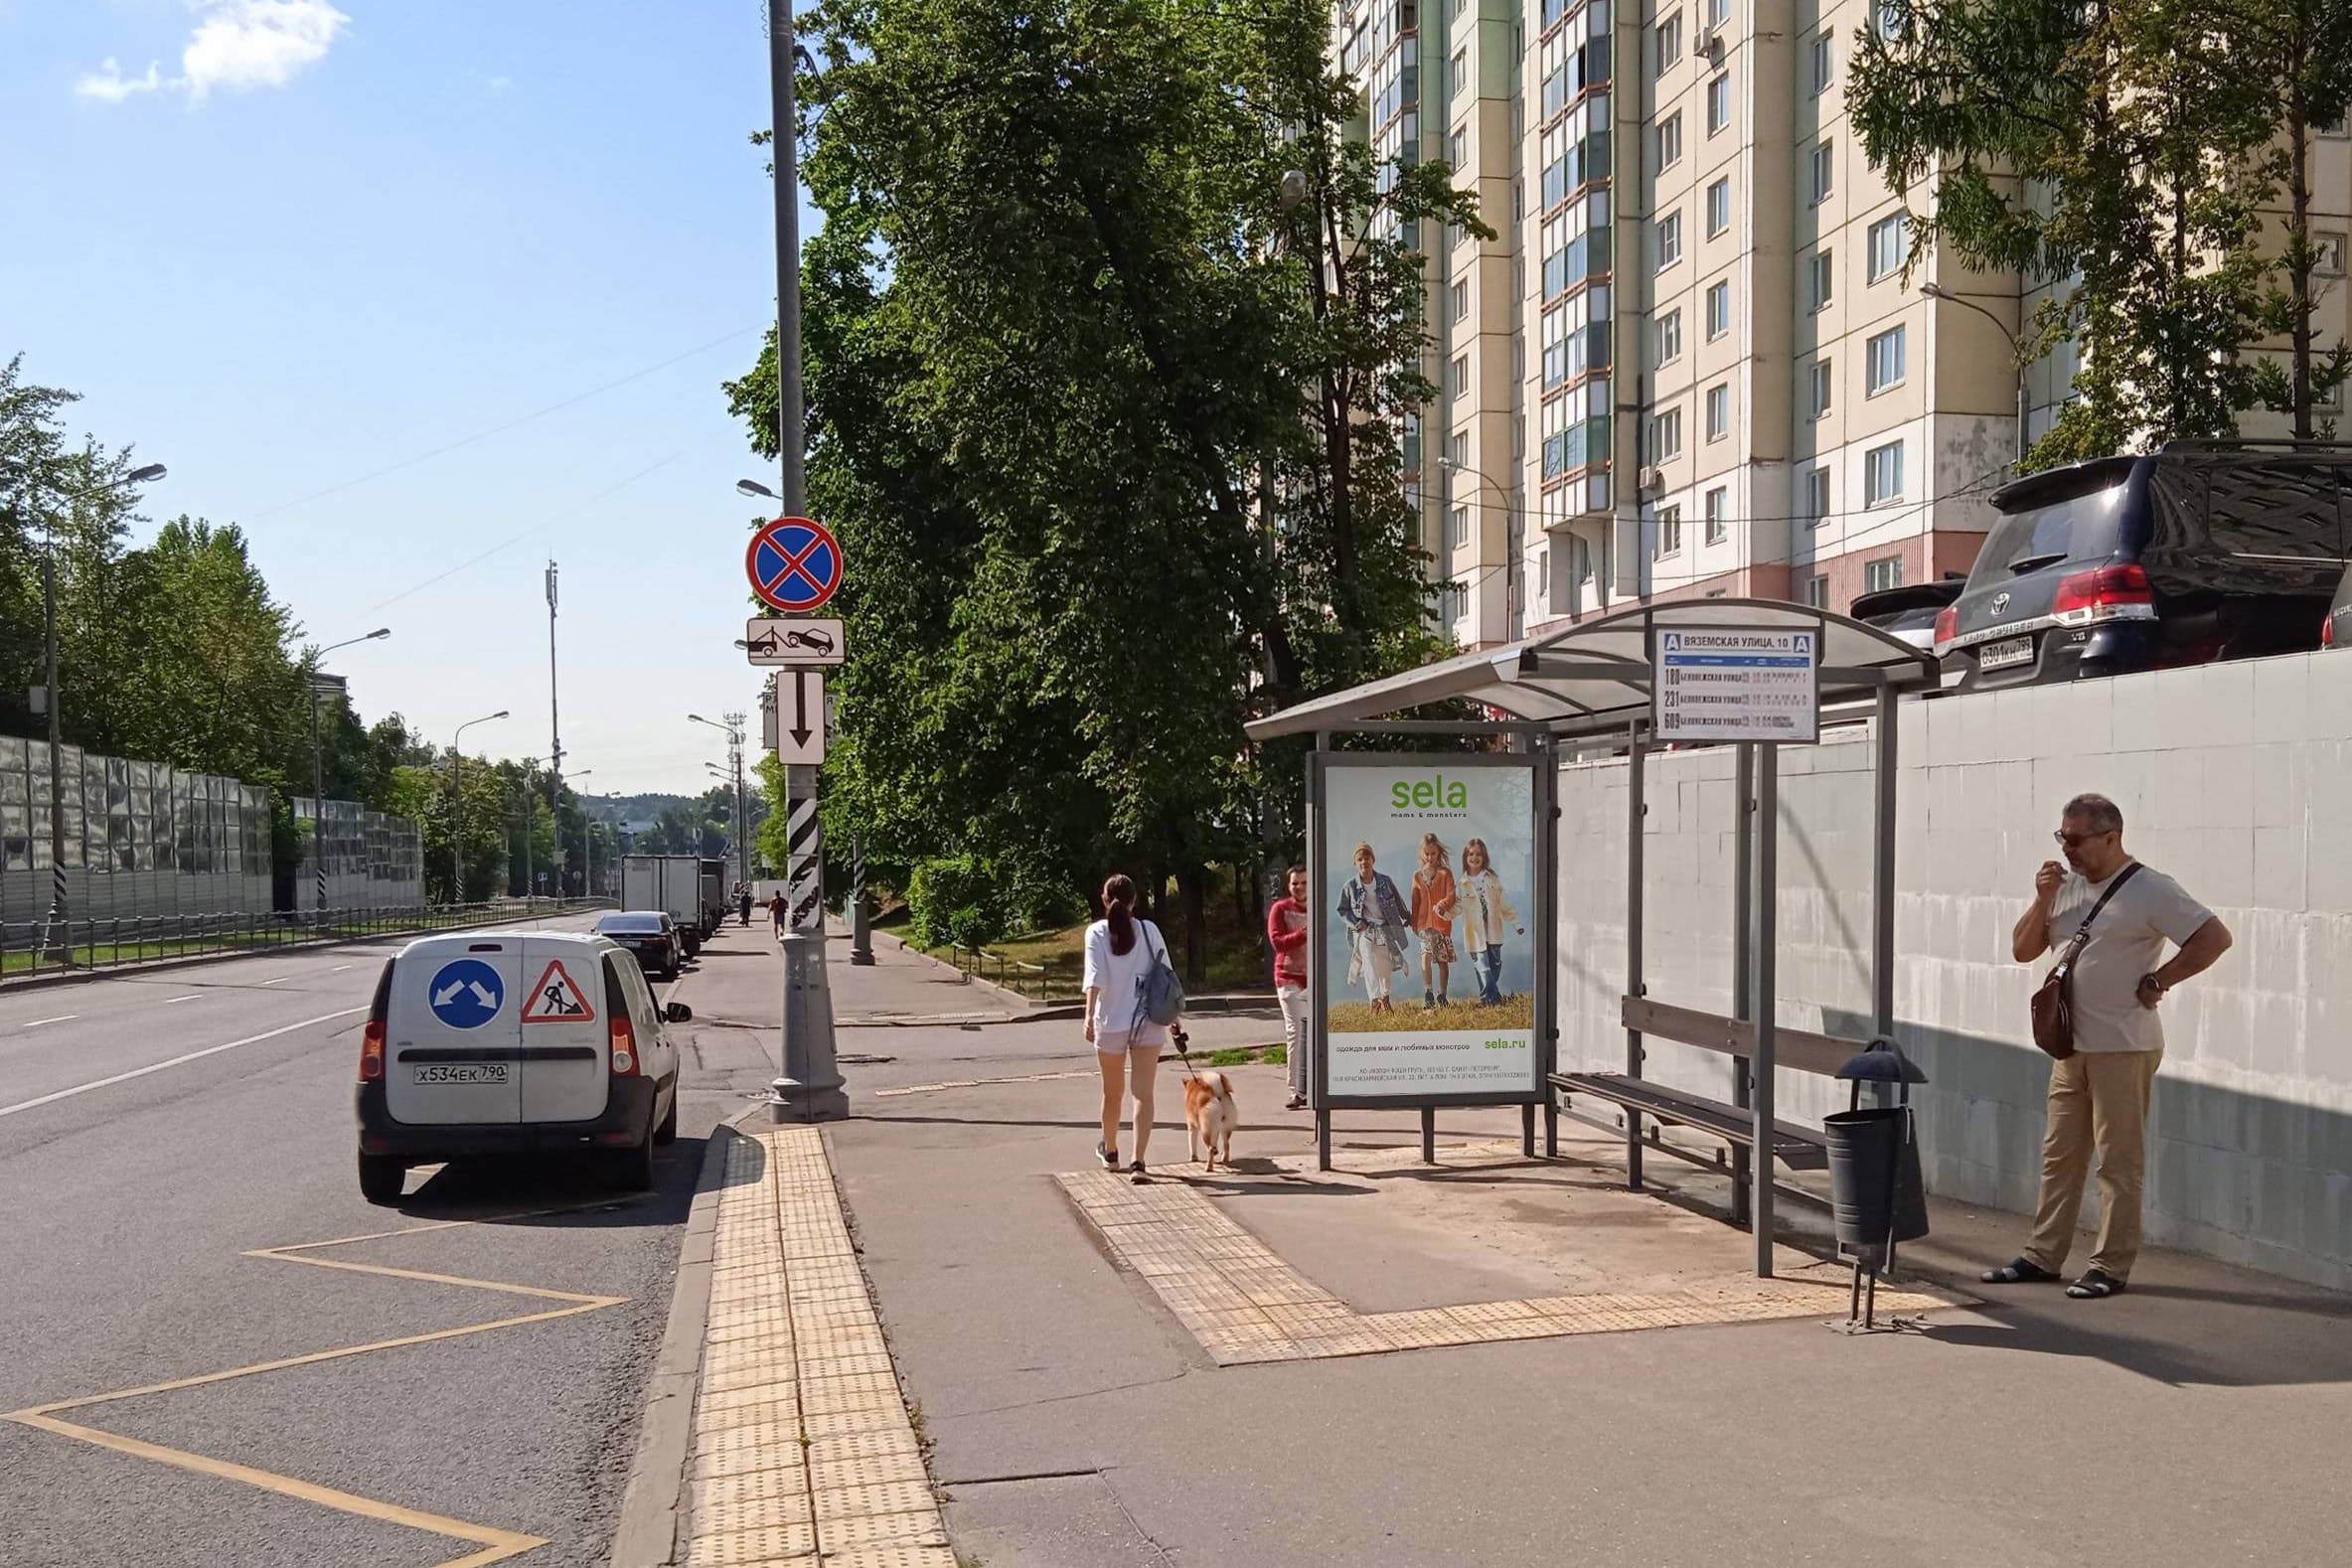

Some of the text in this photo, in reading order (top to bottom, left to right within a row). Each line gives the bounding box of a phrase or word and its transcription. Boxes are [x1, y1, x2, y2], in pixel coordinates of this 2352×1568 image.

[1684, 636, 1739, 647] ВЯЗЕМСКАЯ
[1778, 637, 1789, 648] 10
[1664, 691, 1679, 707] 231
[1664, 712, 1680, 729] 609
[1391, 774, 1468, 809] sela
[1485, 1037, 1526, 1049] sela.ru
[419, 1067, 478, 1082] Х534ЕК
